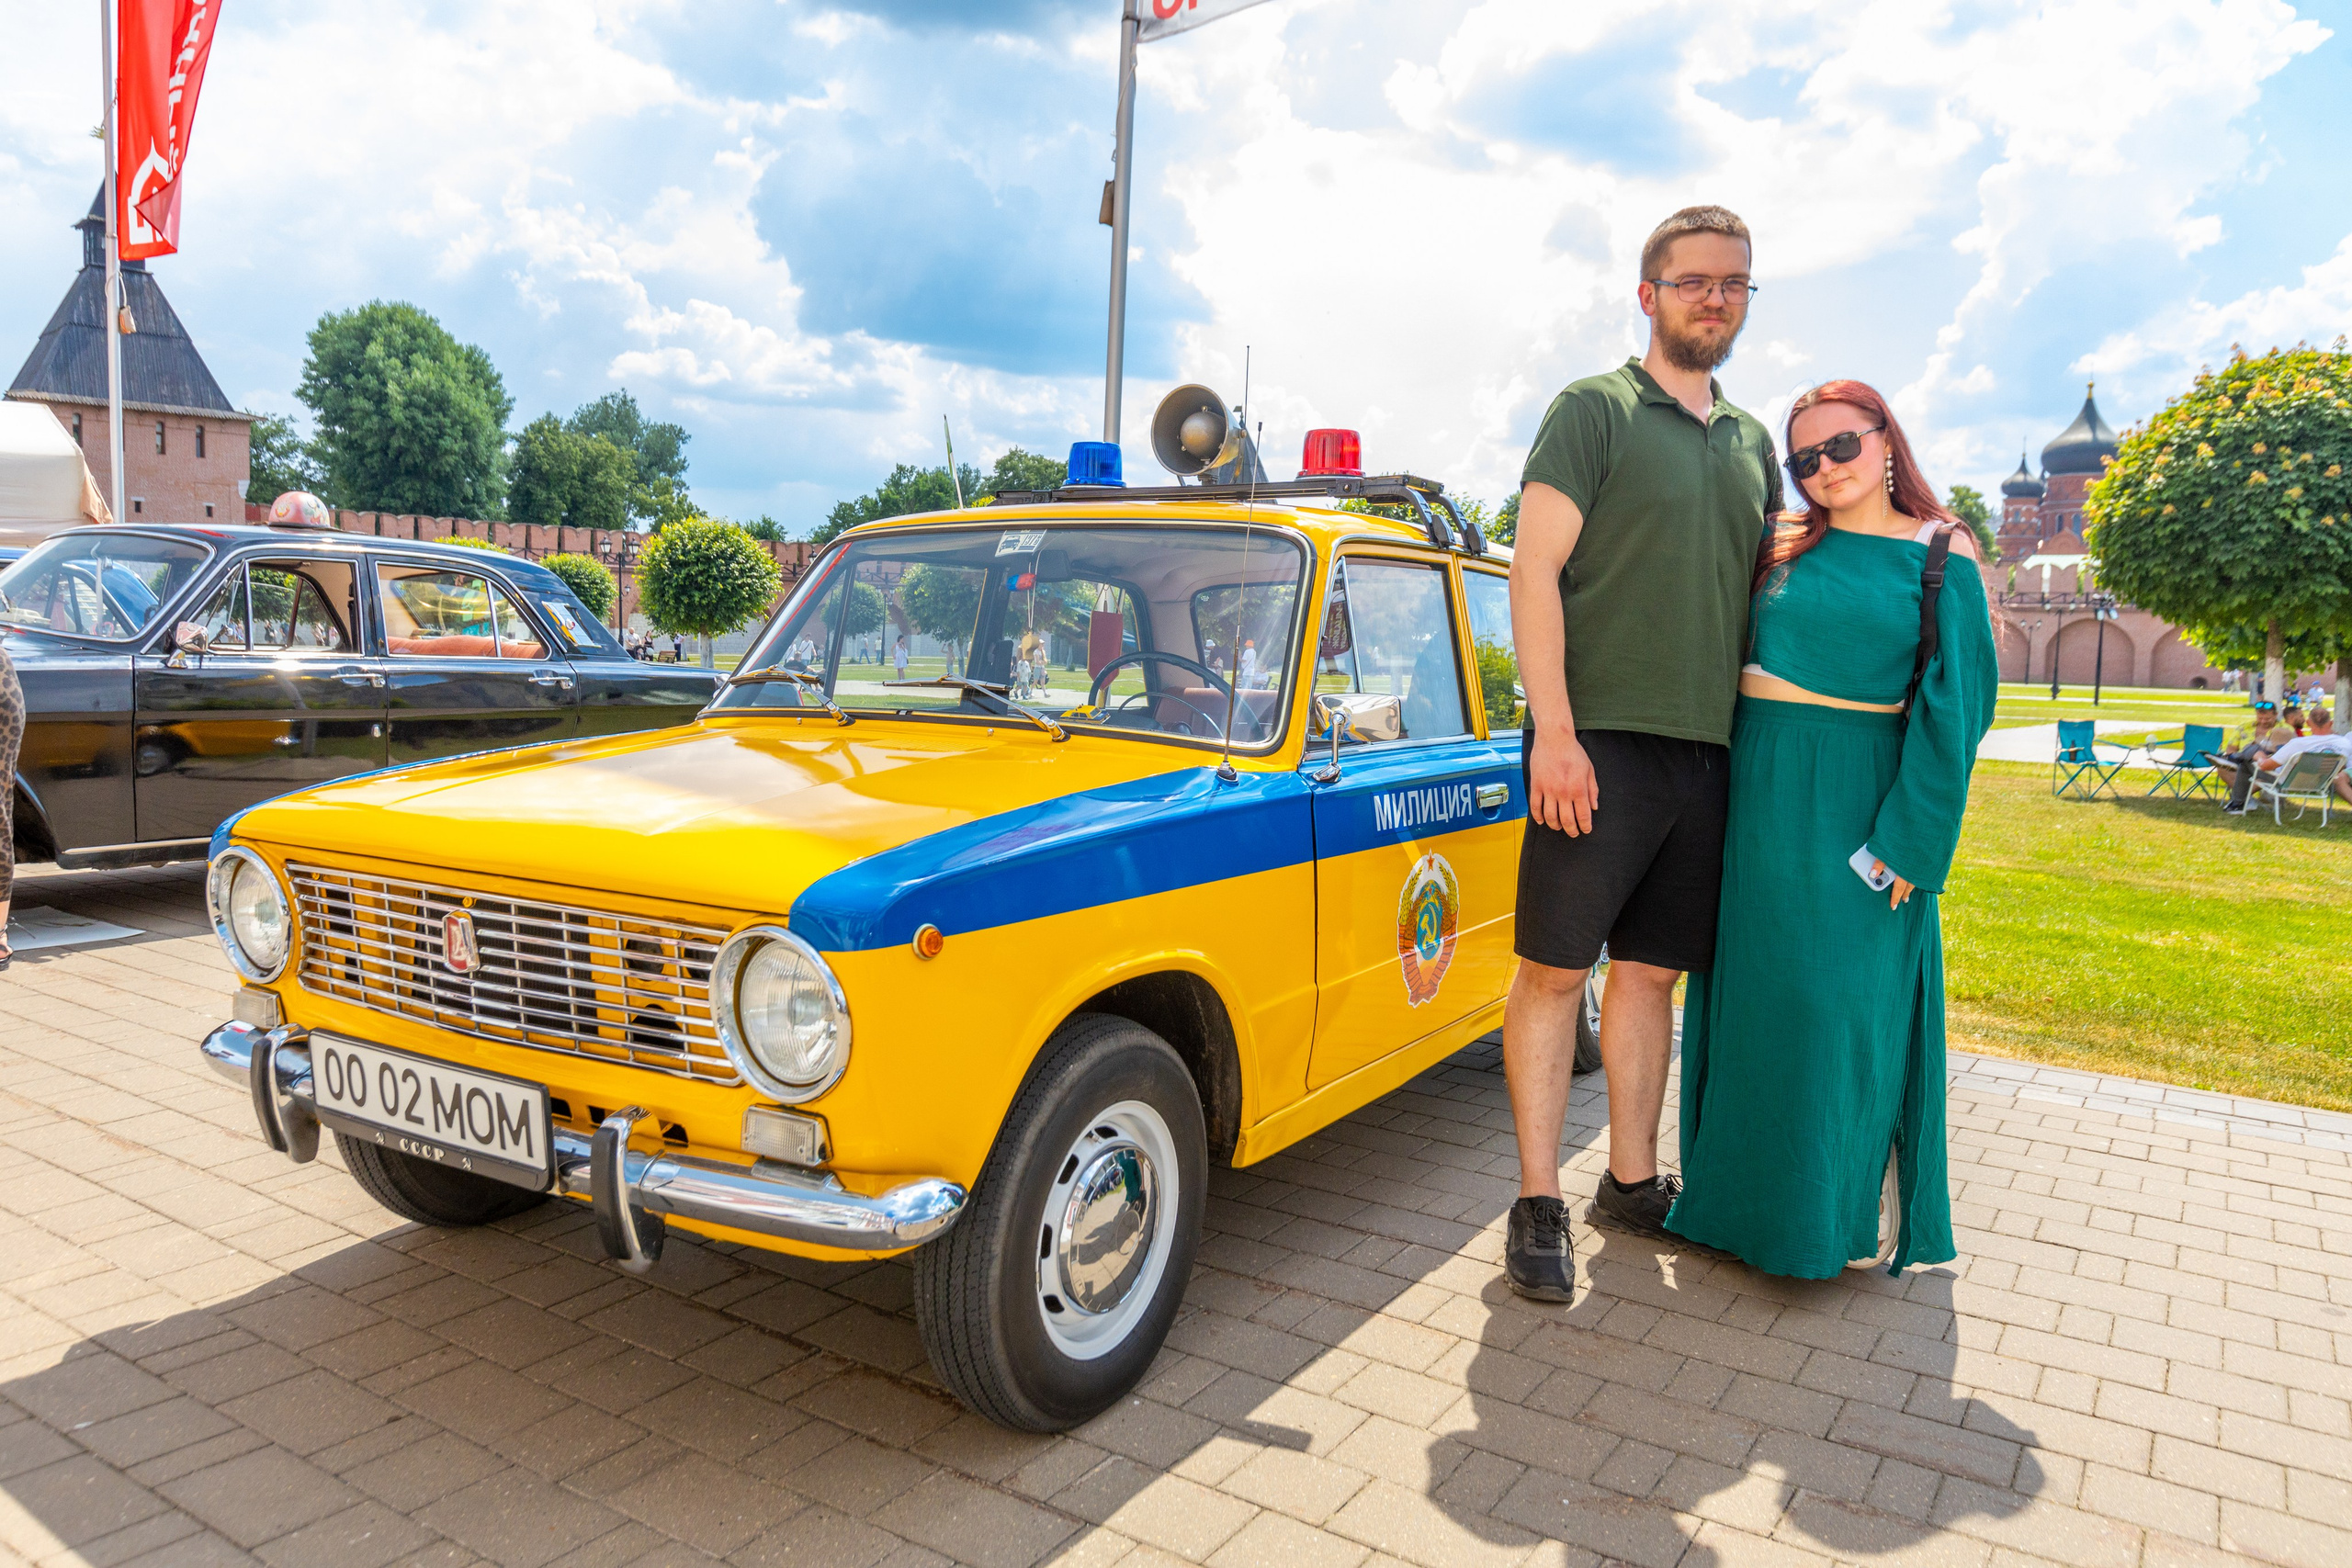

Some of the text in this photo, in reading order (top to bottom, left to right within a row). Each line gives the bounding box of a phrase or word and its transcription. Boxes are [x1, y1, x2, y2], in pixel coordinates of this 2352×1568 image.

[1374, 784, 1472, 832] МИЛИЦИЯ
[430, 1075, 534, 1158] МОМ
[399, 1137, 446, 1162] СССР
